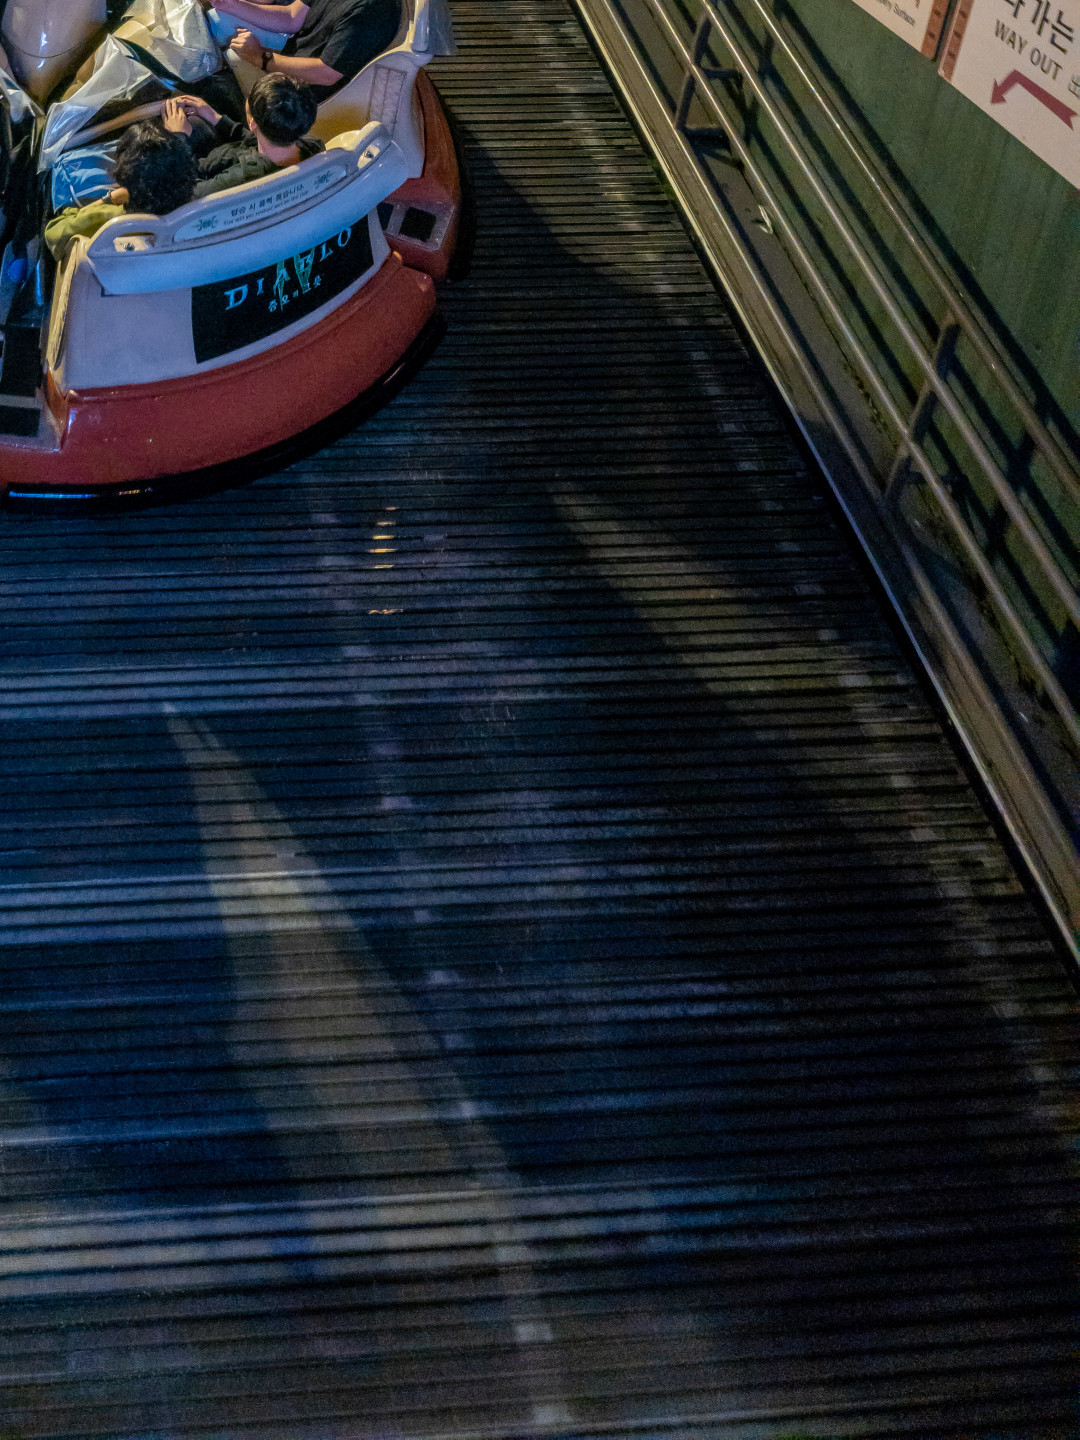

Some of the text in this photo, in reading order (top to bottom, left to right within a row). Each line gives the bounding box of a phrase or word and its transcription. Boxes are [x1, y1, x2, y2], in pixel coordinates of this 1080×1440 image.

[994, 18, 1064, 81] WAY OUT
[223, 226, 353, 311] DIABLO
